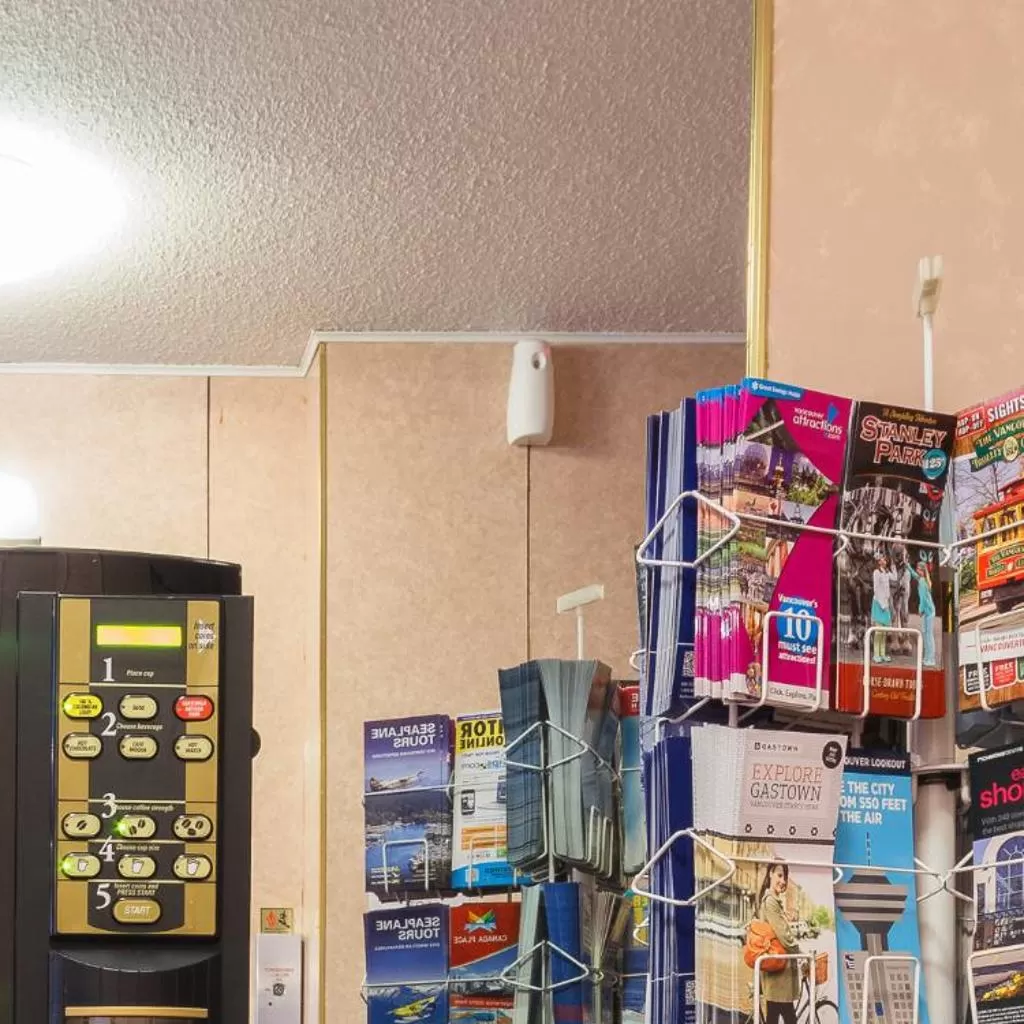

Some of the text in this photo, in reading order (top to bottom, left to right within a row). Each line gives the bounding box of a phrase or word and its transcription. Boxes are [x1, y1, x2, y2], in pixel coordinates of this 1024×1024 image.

[792, 416, 842, 434] attractions
[860, 415, 947, 448] STANLEY
[873, 440, 927, 467] PARK
[783, 607, 812, 641] 10
[778, 641, 817, 654] must see
[103, 657, 115, 681] 1
[101, 712, 117, 736] 2
[752, 763, 823, 783] EXPLORE
[871, 758, 906, 769] LOOKOUT
[750, 782, 822, 801] GASTOWN
[847, 781, 869, 794] THE
[870, 783, 895, 796] CITY
[102, 793, 117, 818] 3
[881, 798, 907, 812] FEET
[840, 810, 883, 825] THE AIR
[99, 836, 115, 862] 4
[96, 883, 111, 910] 5
[123, 905, 152, 916] START
